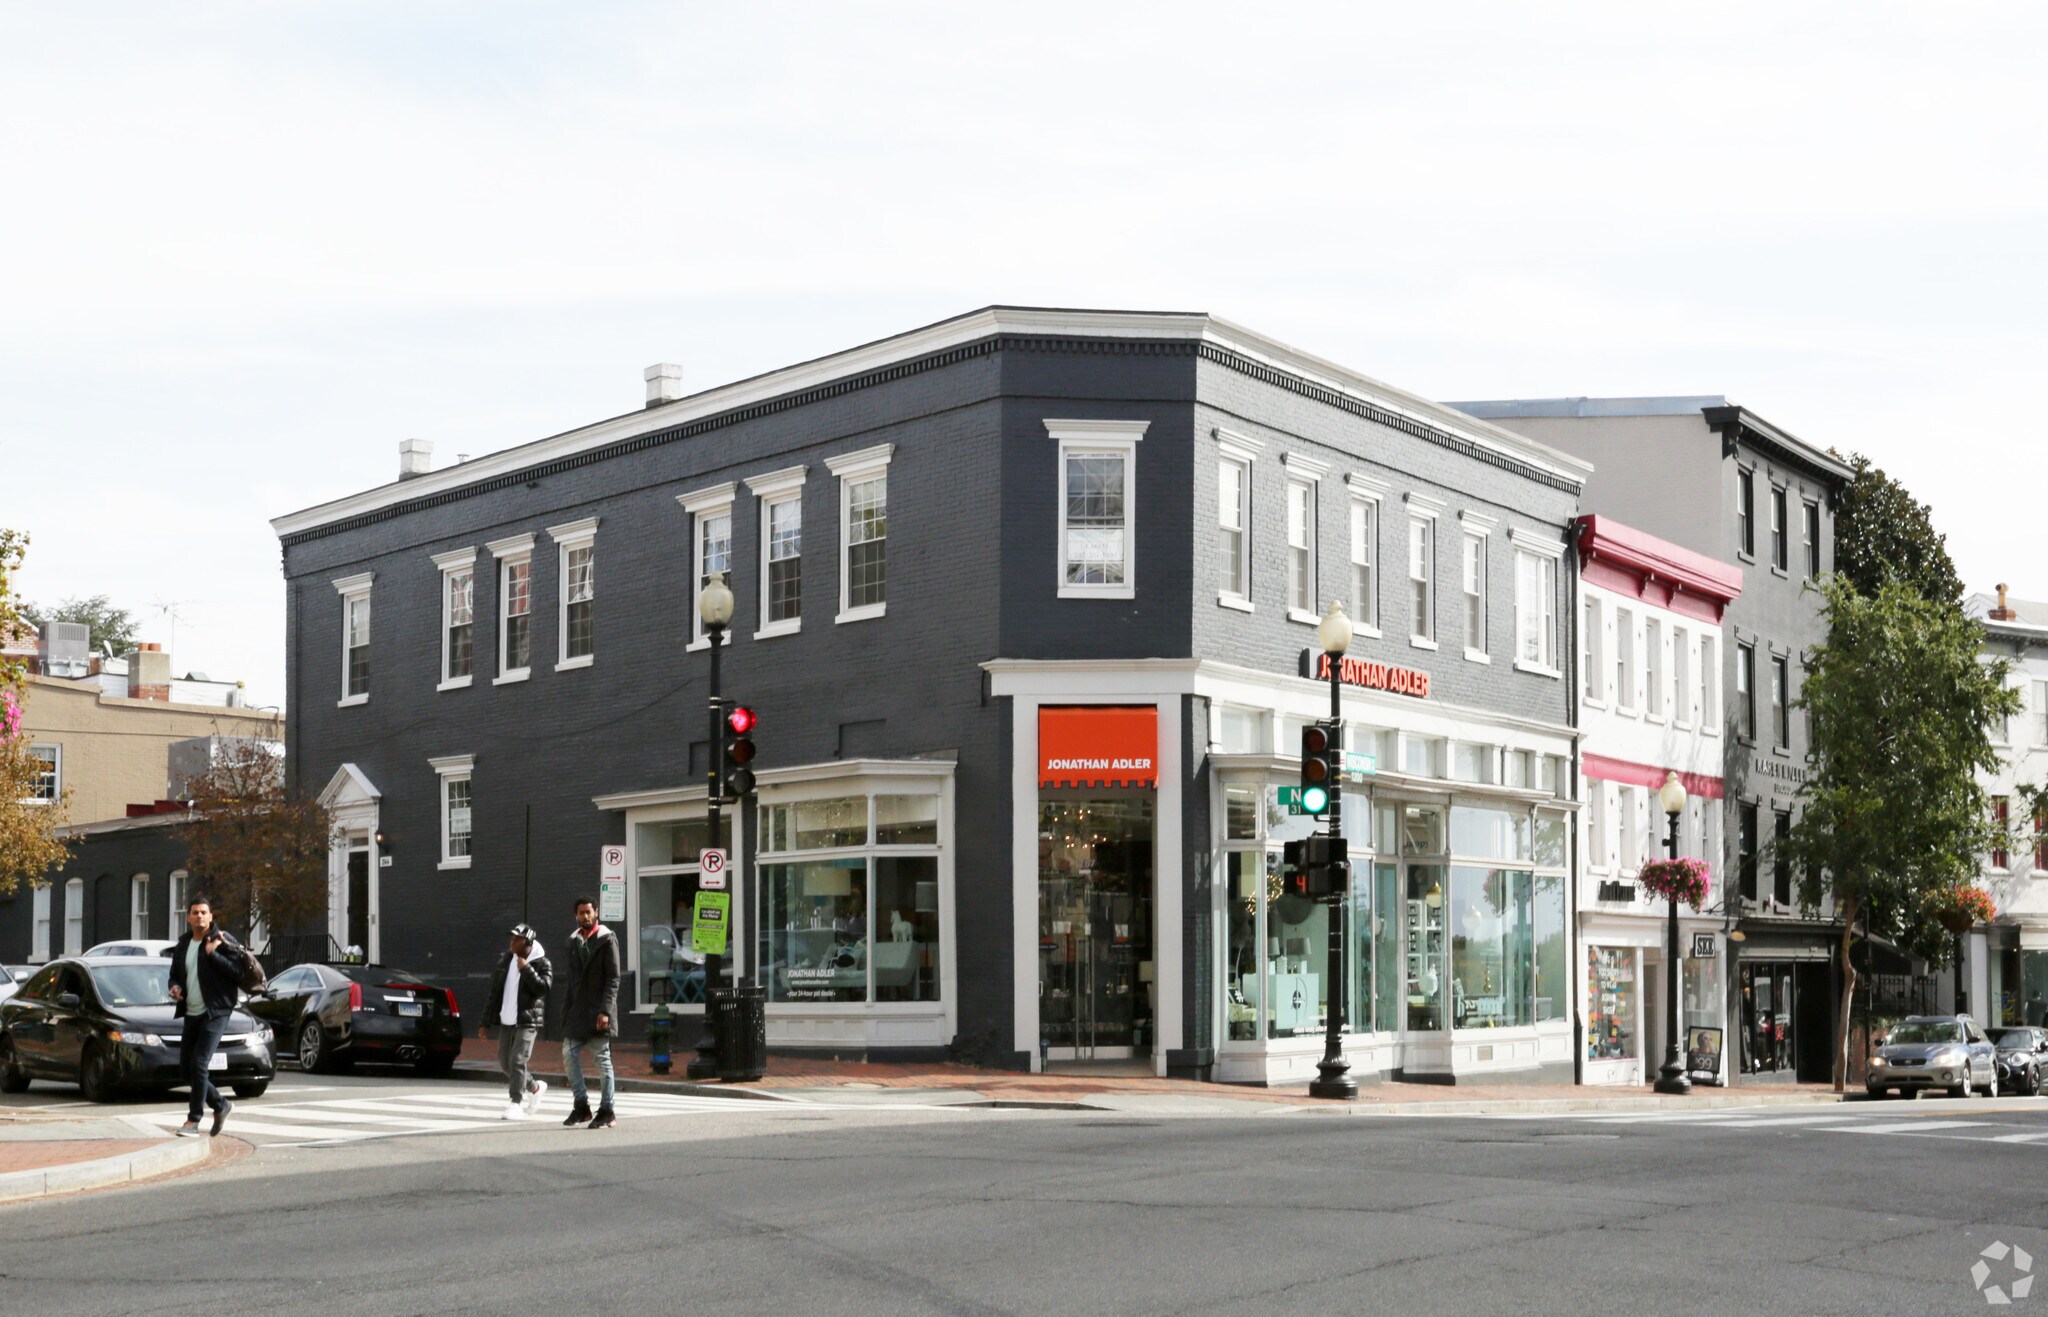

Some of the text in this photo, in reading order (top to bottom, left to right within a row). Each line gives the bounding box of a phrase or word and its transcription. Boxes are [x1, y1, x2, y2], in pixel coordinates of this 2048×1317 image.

[1390, 667, 1430, 696] ADLER
[1047, 758, 1151, 770] JONATHAN ADLER
[1290, 788, 1301, 803] N
[1696, 936, 1714, 956] SEE
[788, 968, 835, 978] JONATHAN ADLER
